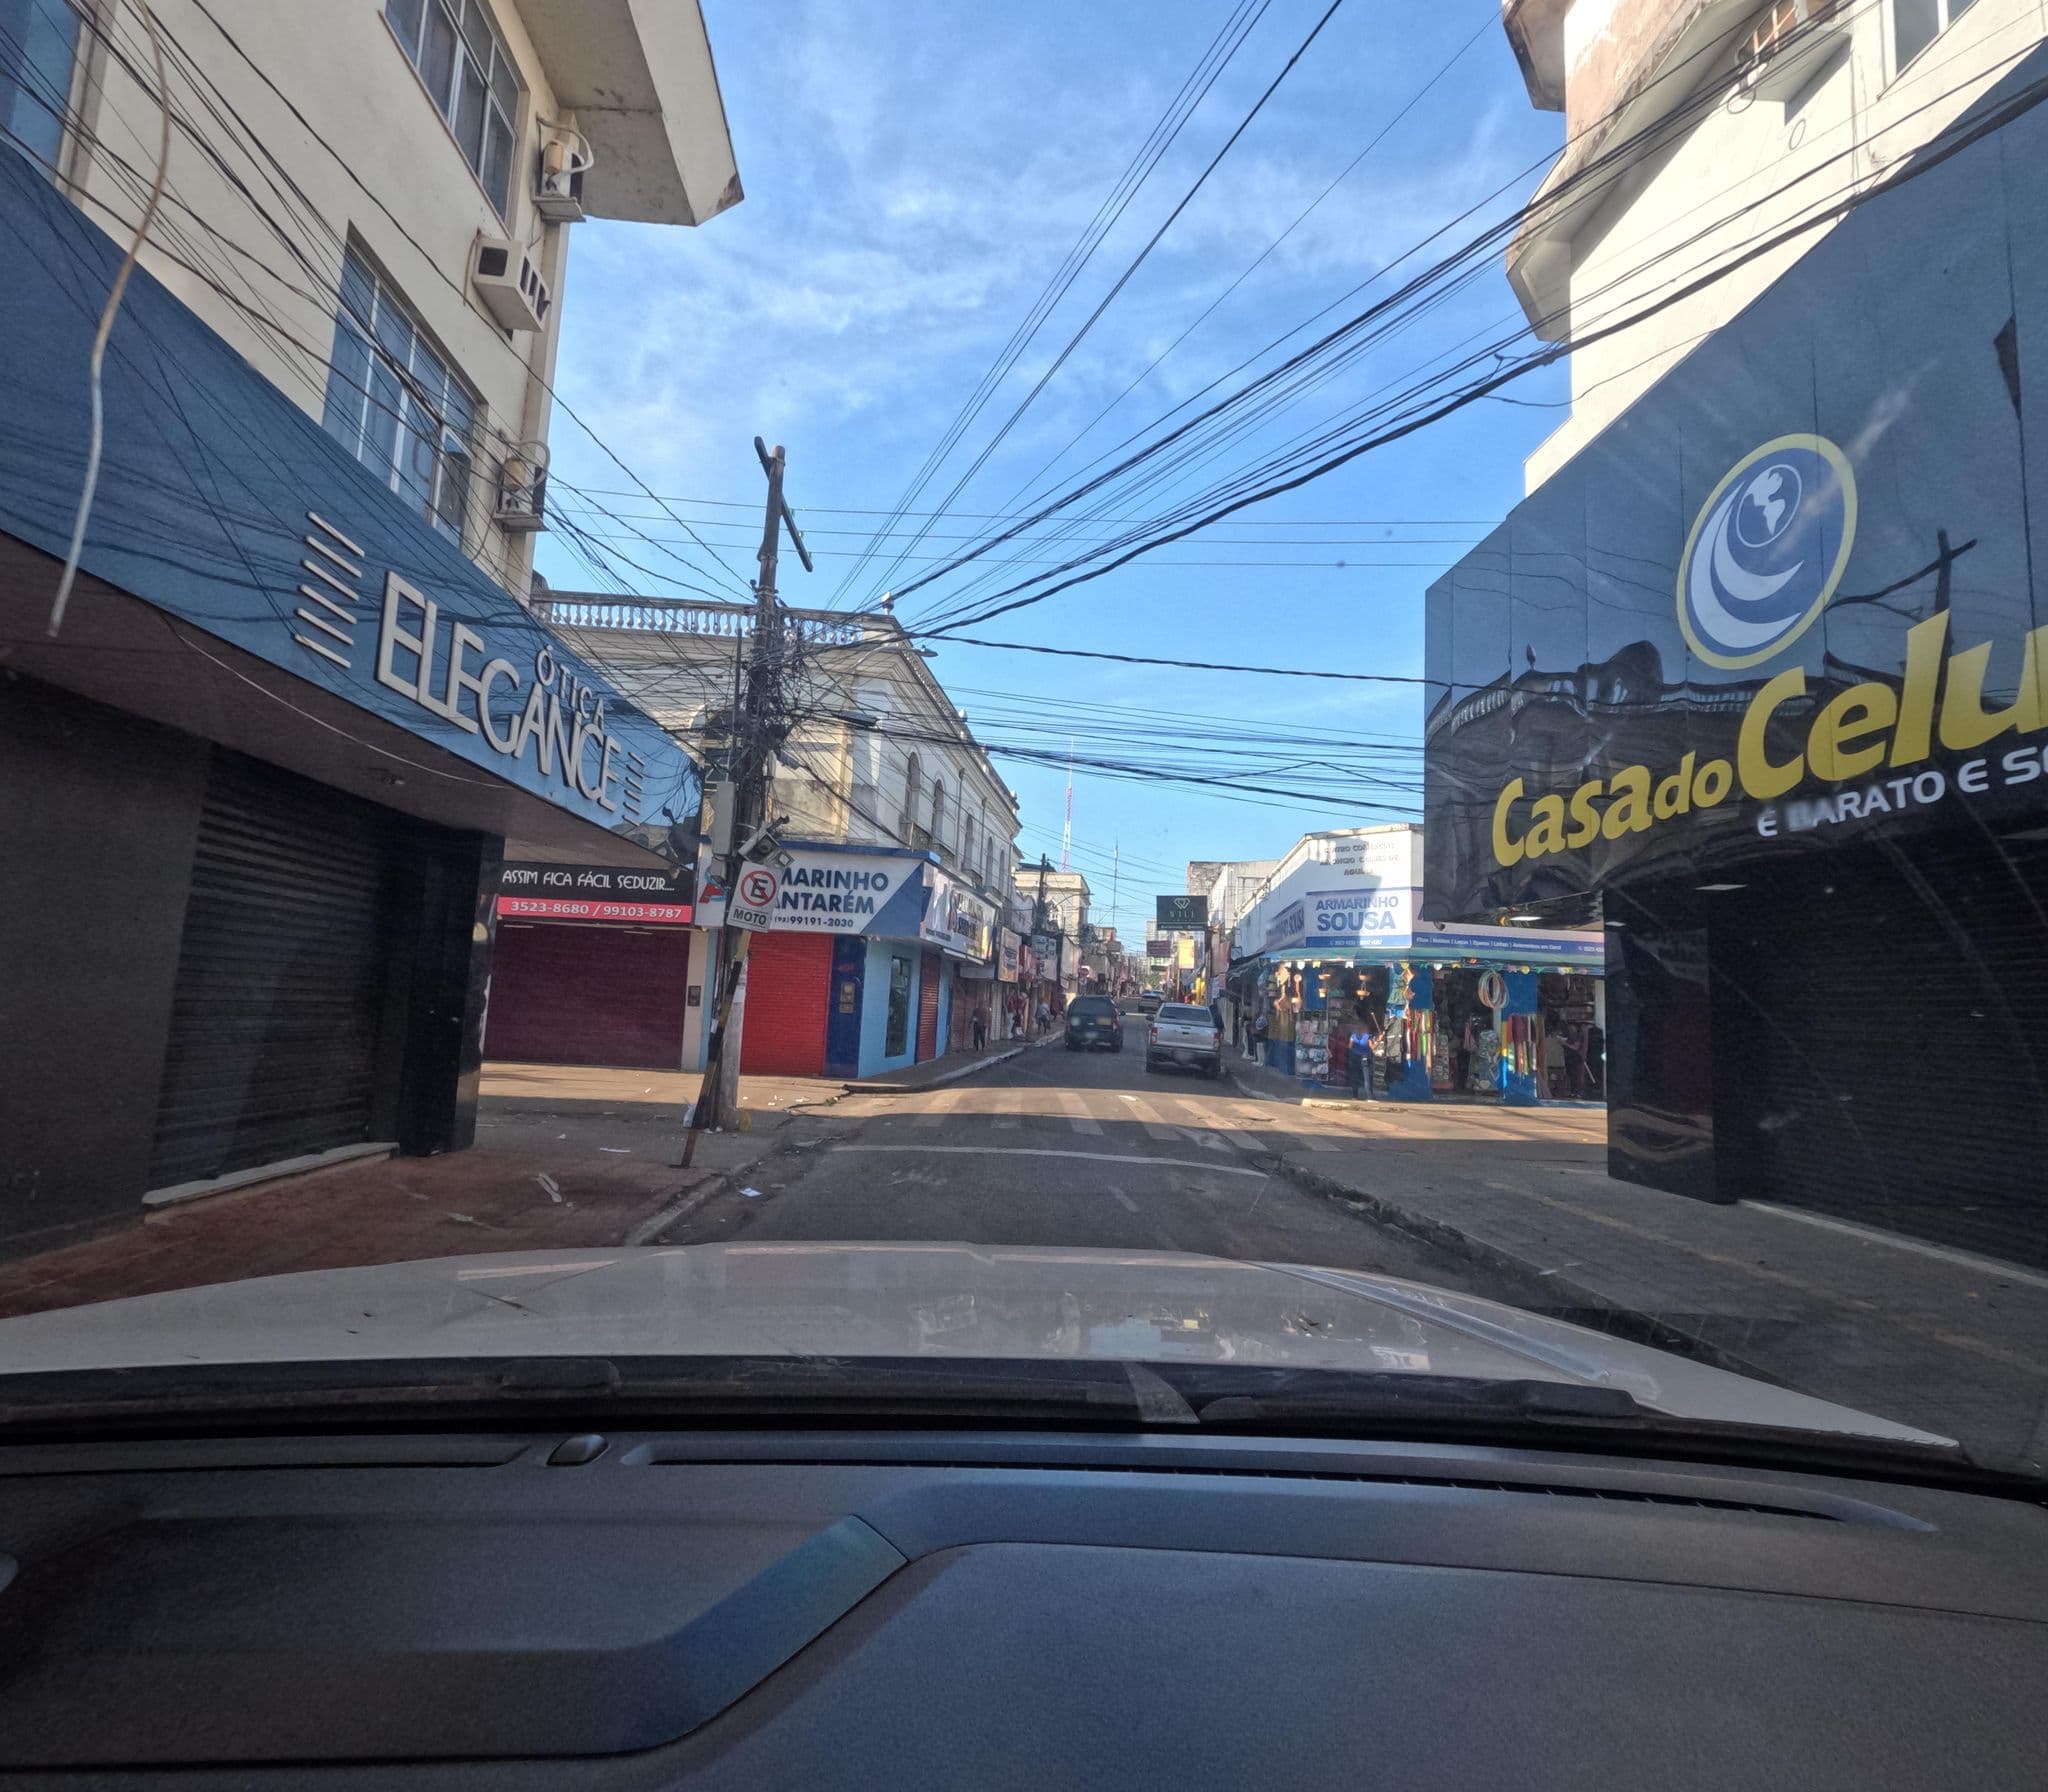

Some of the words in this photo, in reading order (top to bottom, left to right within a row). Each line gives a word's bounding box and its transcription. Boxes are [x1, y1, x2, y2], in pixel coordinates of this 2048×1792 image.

[376, 571, 622, 812] ELEGANCE
[536, 644, 605, 733] ÓTICA
[1957, 758, 1990, 793] E
[2001, 747, 2048, 786] S
[502, 870, 538, 885] ASSIM
[543, 872, 572, 886] FICA
[577, 871, 611, 889] FÁCIL
[511, 901, 589, 914] 3523-8680
[603, 905, 682, 919] 99103-8787
[1316, 896, 1399, 911] ARMARINHO
[733, 908, 768, 926] MOTO
[1317, 911, 1397, 931] SOUSA
